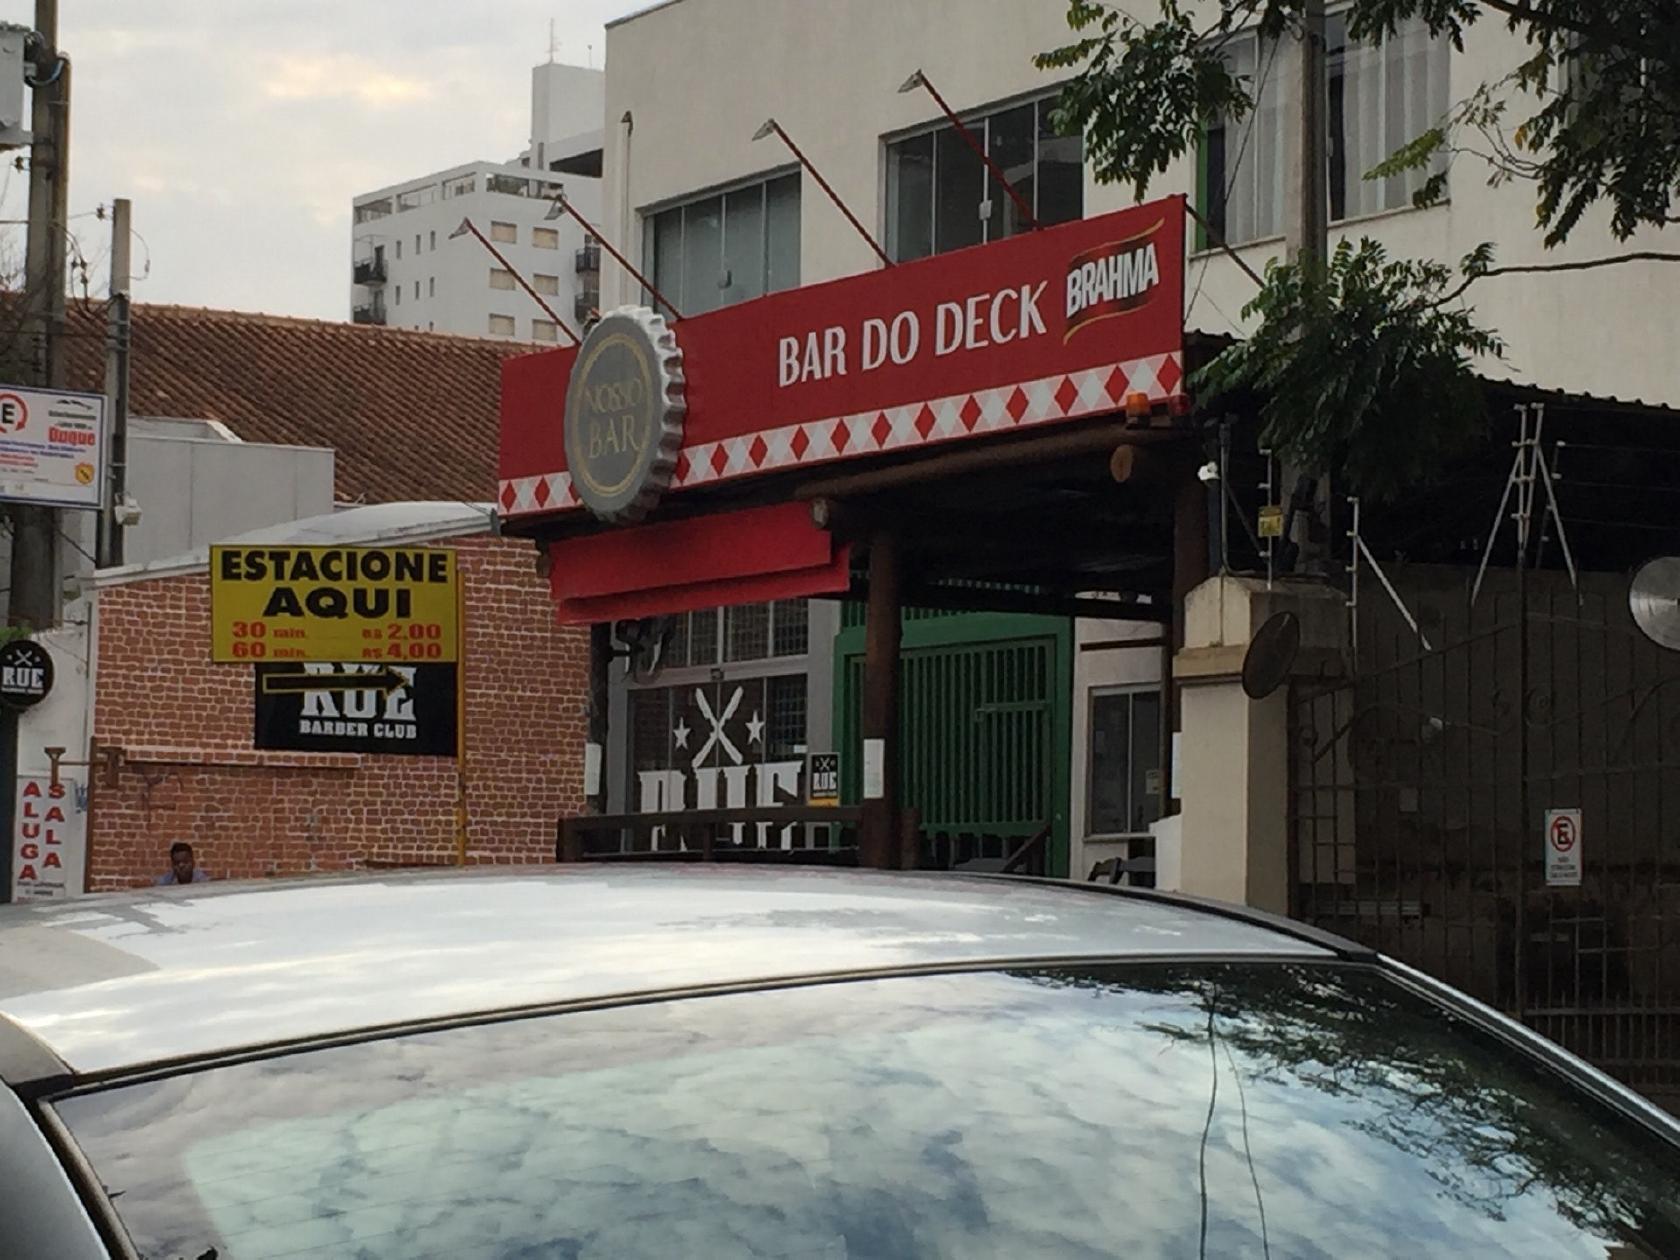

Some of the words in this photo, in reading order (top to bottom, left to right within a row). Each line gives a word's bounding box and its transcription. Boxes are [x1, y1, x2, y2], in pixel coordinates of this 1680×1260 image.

[1066, 242, 1160, 318] BRAHMA
[778, 326, 847, 388] BAR
[861, 310, 919, 372] DO
[935, 280, 1048, 356] DECK
[585, 379, 641, 413] NOSSO
[589, 415, 640, 458] BAR
[221, 549, 448, 583] ESTACIONE
[263, 587, 411, 619] AQUI
[232, 621, 267, 639] 30
[232, 641, 267, 659] 60
[2, 666, 44, 688] RUE
[299, 719, 368, 737] BARBER
[373, 723, 417, 739] CLUB
[19, 781, 42, 880] ALUGA
[43, 784, 65, 868] SALA
